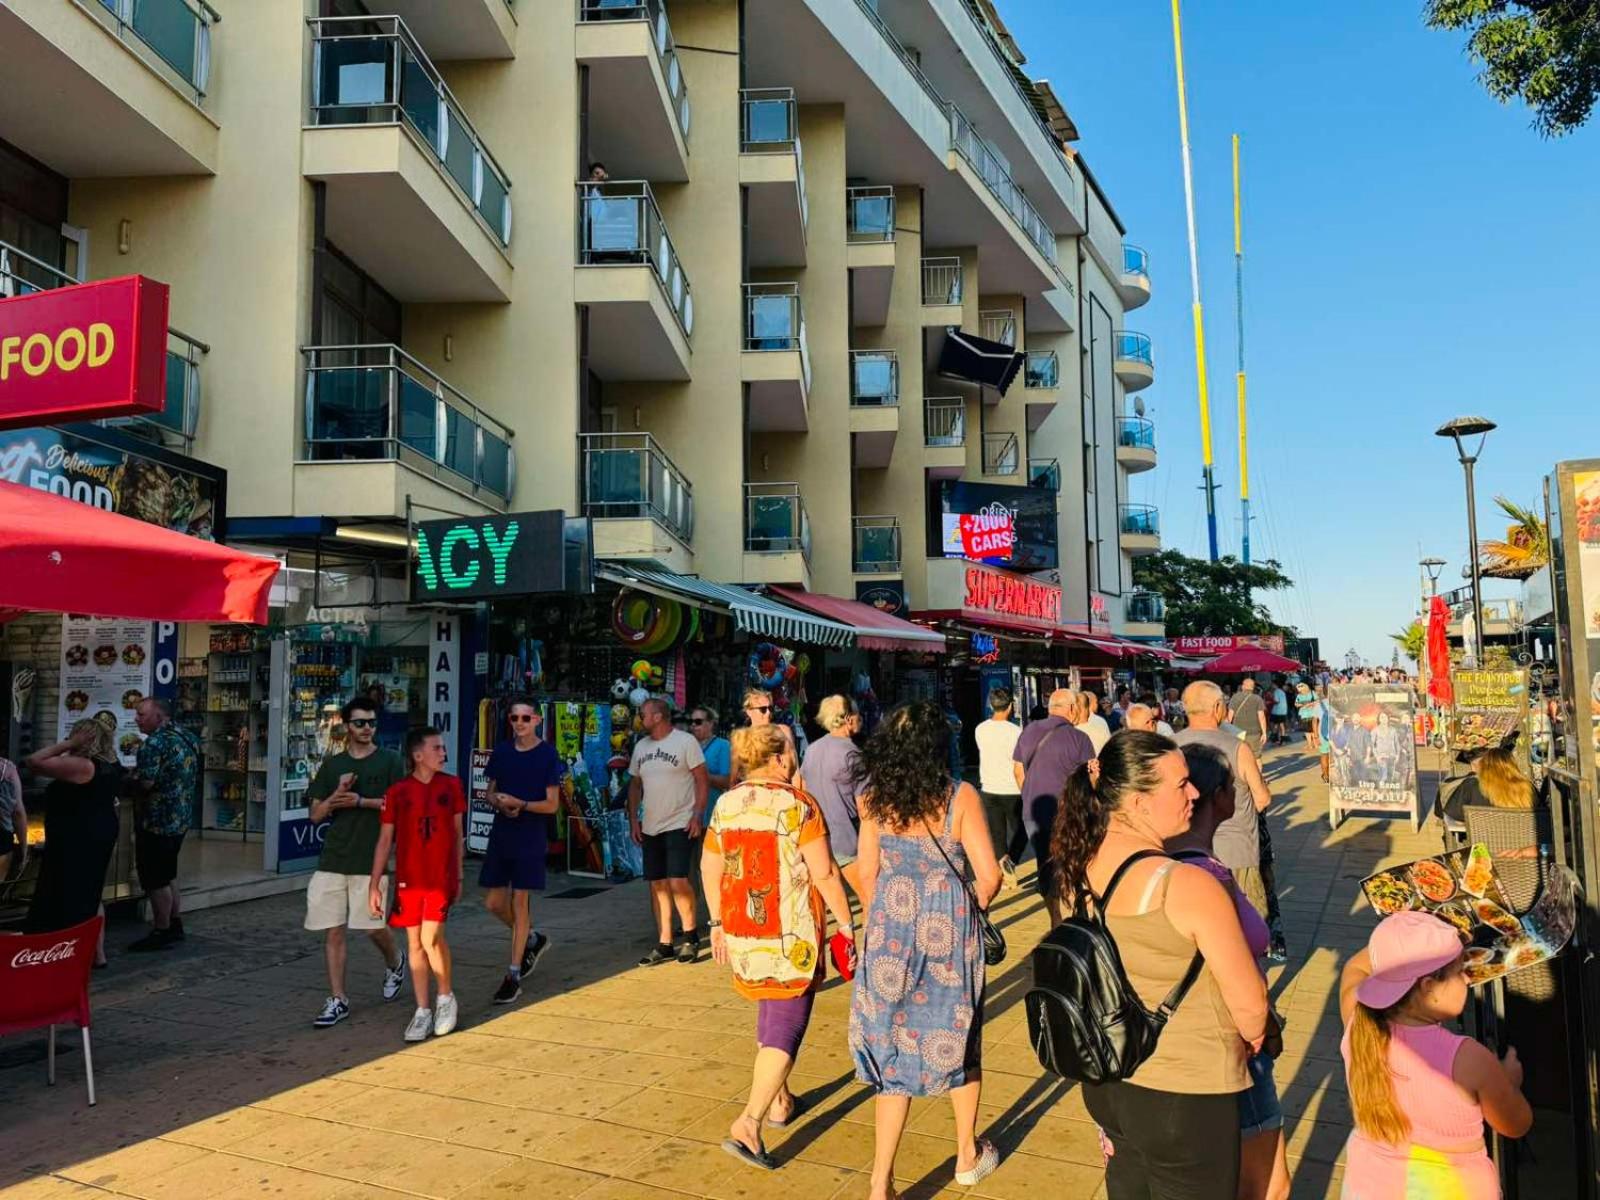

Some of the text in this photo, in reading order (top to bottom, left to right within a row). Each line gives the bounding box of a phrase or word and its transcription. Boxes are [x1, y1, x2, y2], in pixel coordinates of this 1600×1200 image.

[1, 322, 115, 381] FOOD
[44, 443, 110, 481] Delicious
[971, 531, 1011, 553] CARS
[965, 568, 1062, 622] SUPERMARKET
[1181, 637, 1204, 648] FAST
[1205, 636, 1232, 647] FOOD
